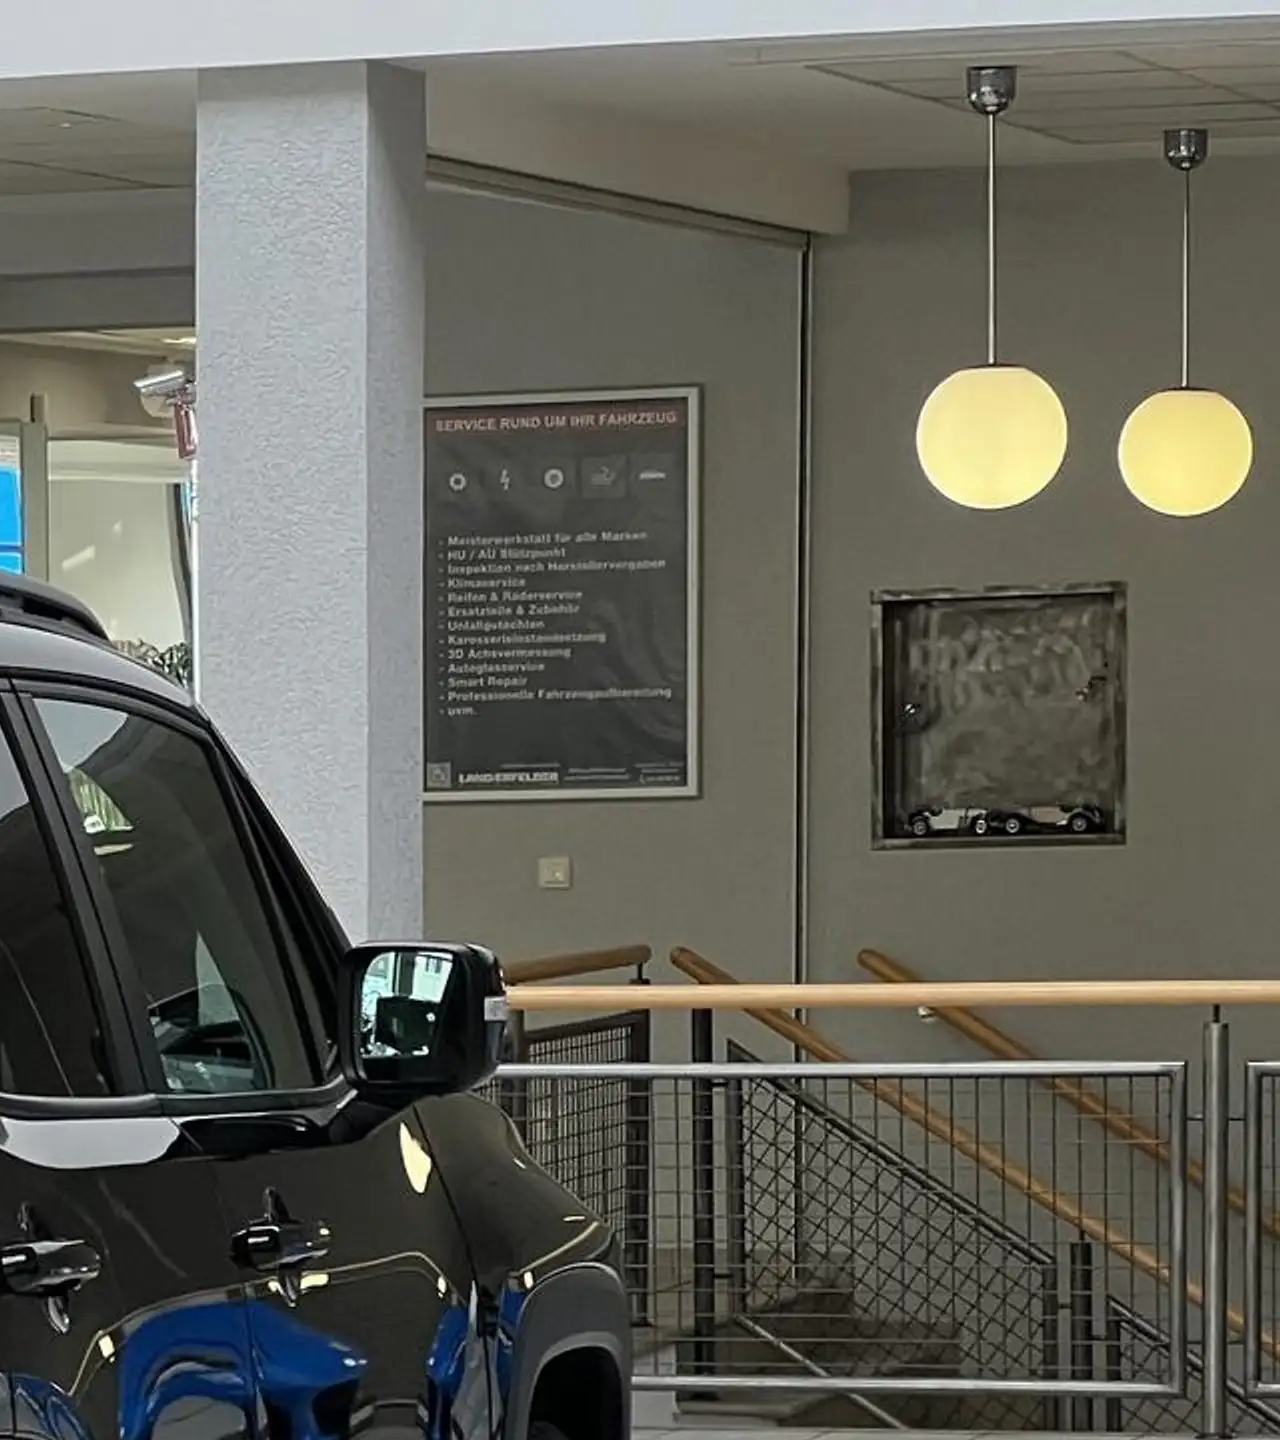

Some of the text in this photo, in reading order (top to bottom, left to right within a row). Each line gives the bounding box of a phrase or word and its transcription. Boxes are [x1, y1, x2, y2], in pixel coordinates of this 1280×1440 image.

[436, 411, 677, 432] SERVICE RUND UM IHR FAHRZEUG
